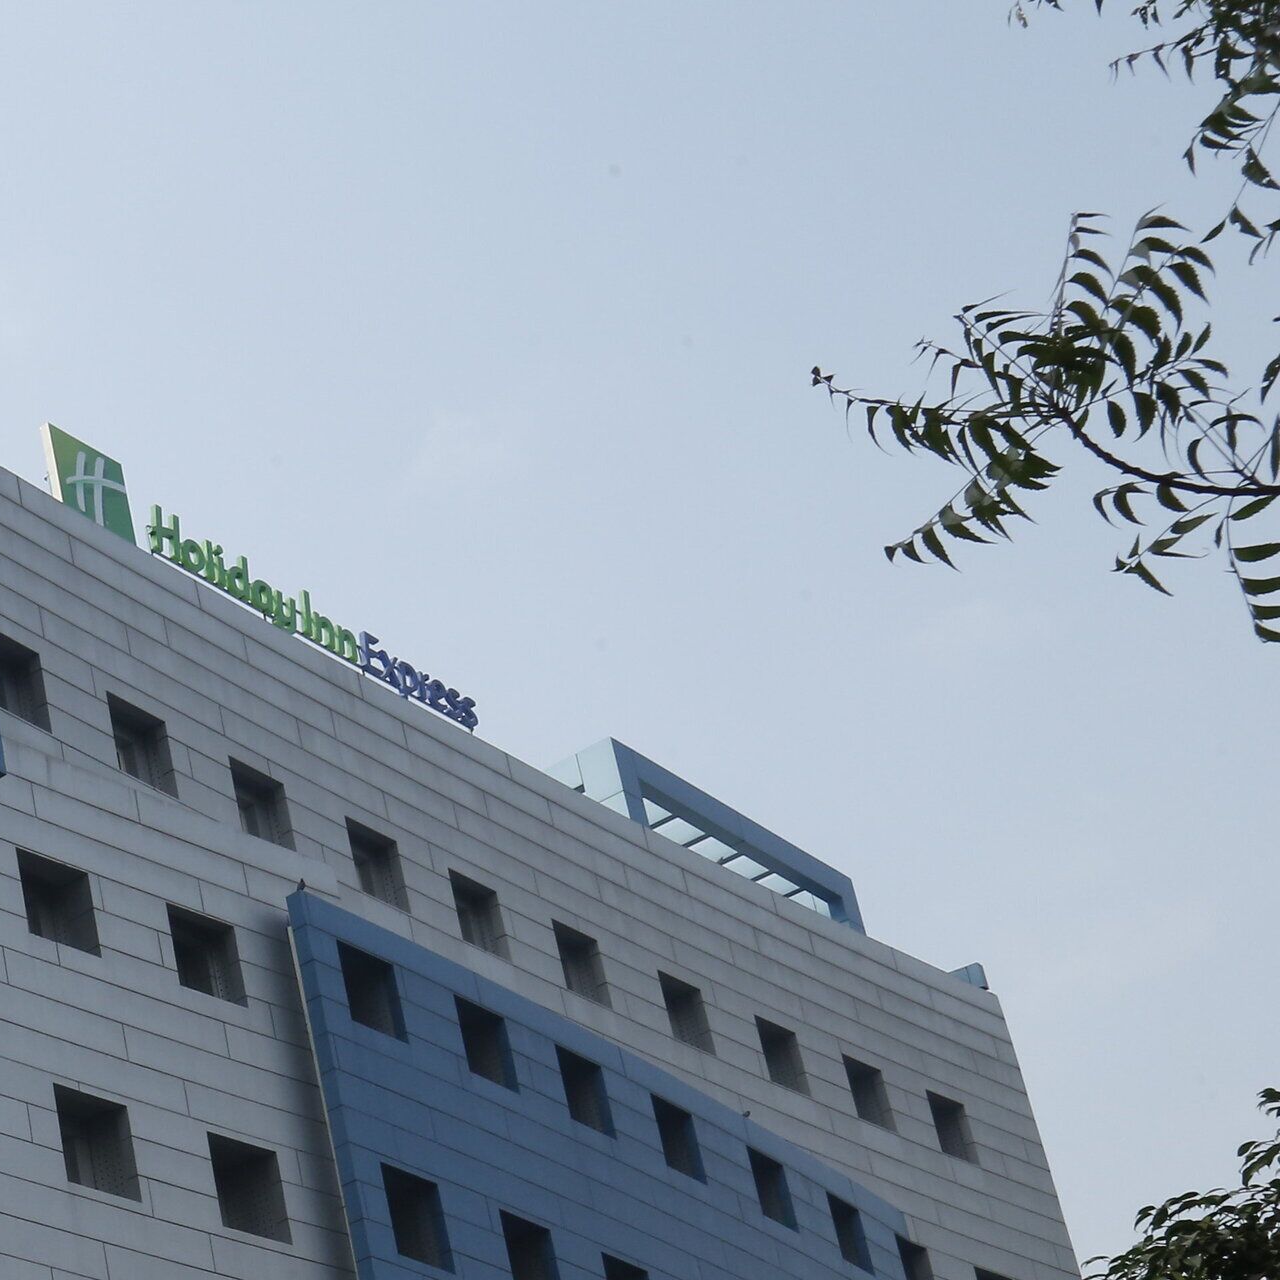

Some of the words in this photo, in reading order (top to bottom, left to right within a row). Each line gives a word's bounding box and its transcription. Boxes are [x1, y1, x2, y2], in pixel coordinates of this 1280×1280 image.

[147, 504, 297, 634] Holiday
[299, 589, 360, 663] Inn
[359, 630, 479, 731] Express
